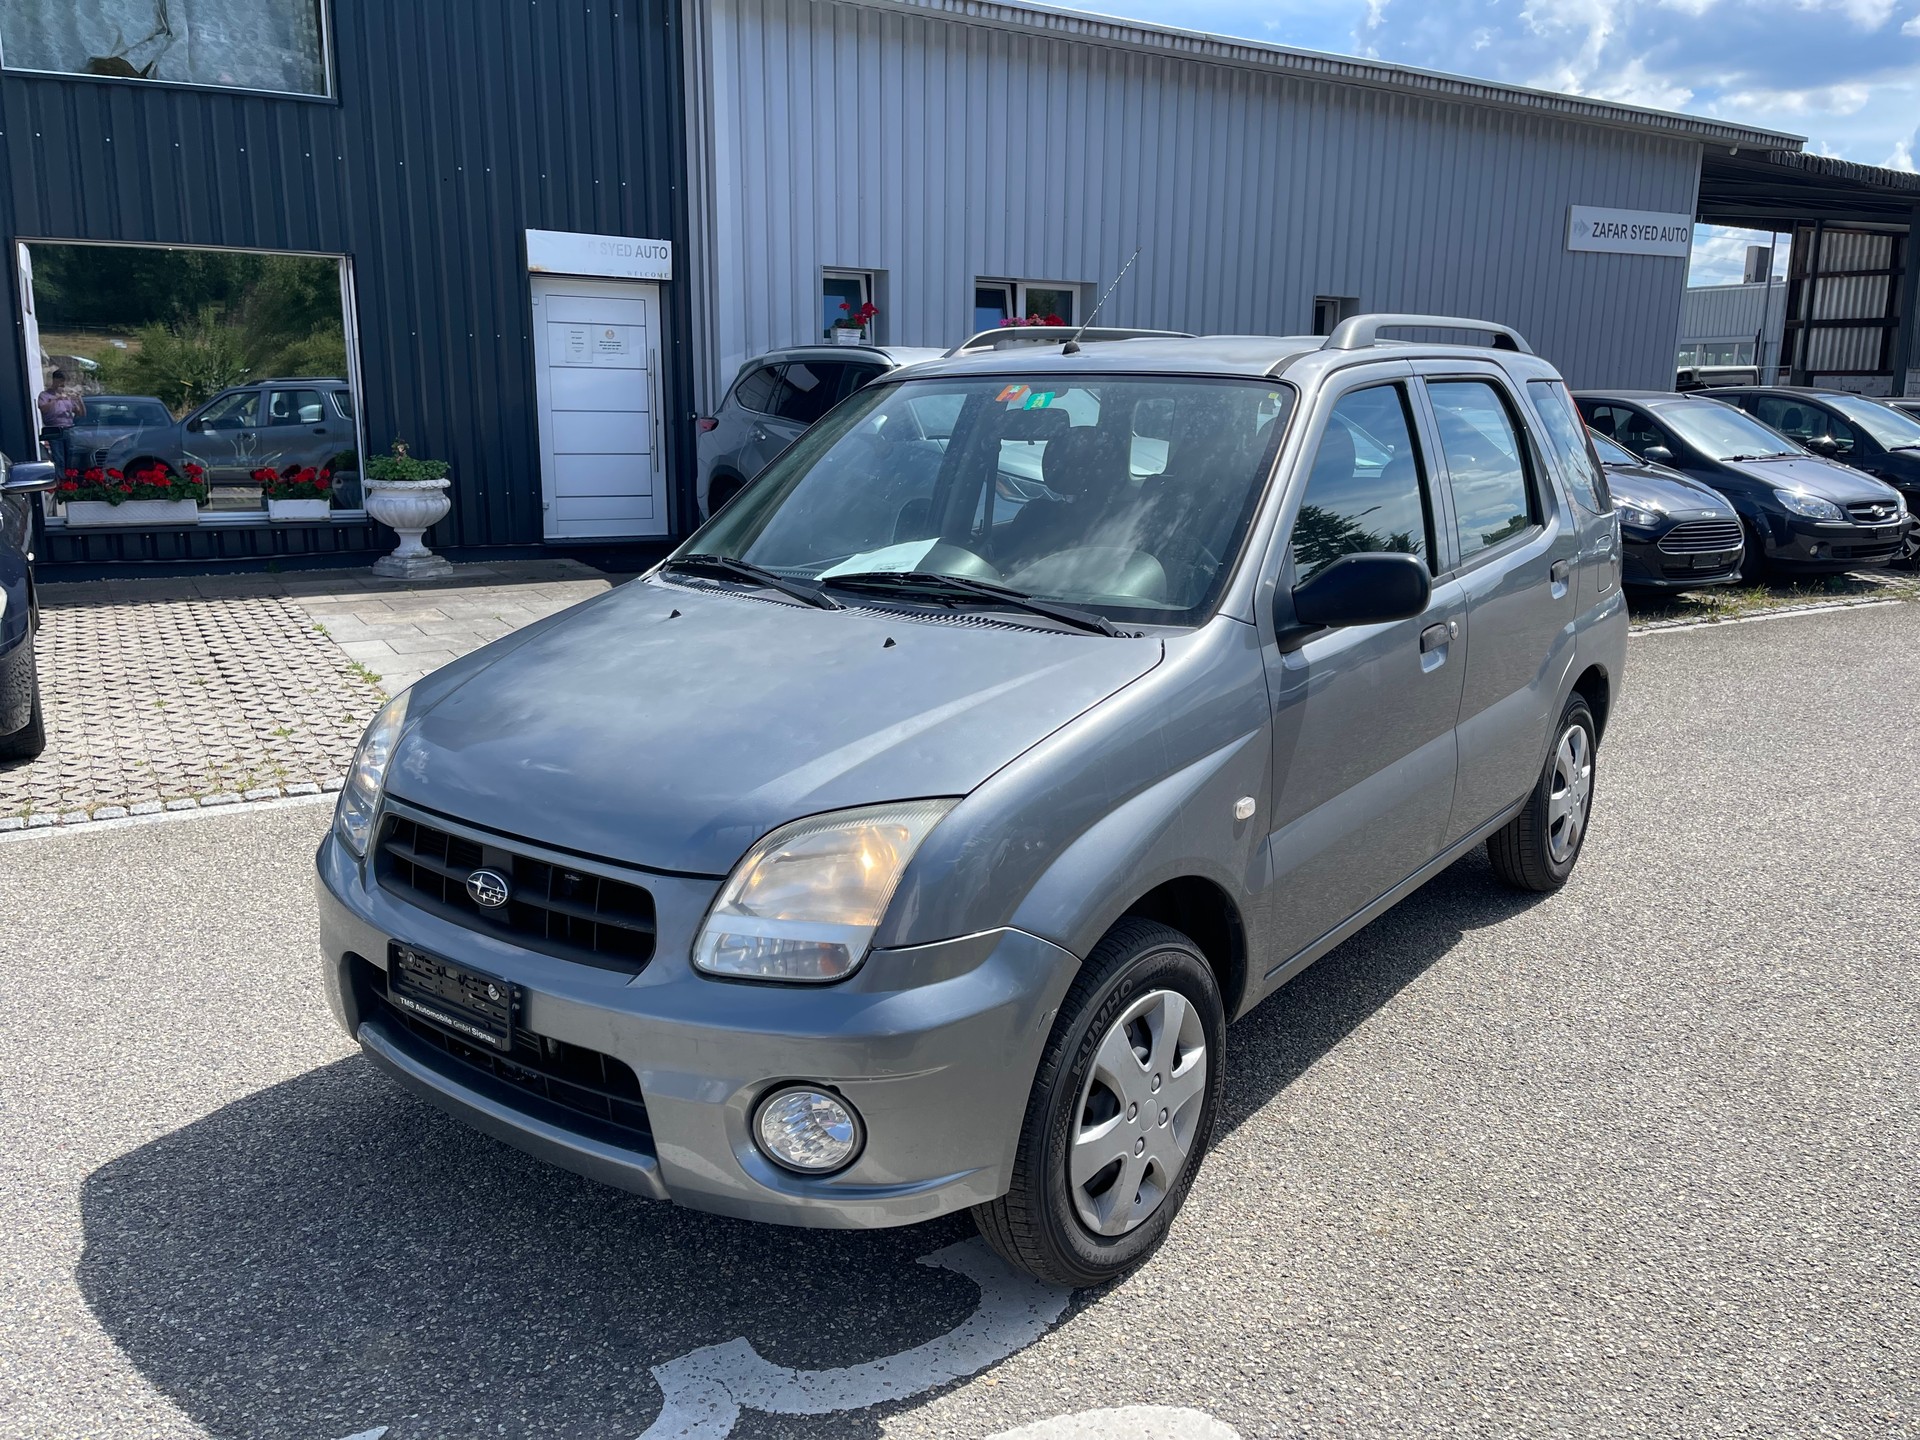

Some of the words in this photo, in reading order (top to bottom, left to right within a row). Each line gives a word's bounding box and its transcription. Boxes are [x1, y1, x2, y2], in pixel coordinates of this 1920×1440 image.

[1592, 221, 1628, 239] ZAFAR
[1630, 224, 1658, 241] SYED
[1659, 226, 1688, 243] AUTO
[600, 242, 632, 257] SYED
[635, 244, 668, 260] AUTO
[626, 270, 670, 279] WELCOME
[400, 996, 415, 1009] TMS
[415, 1003, 453, 1025] Automobile
[453, 1020, 471, 1033] GmbH
[471, 1027, 496, 1044] Signau
[1072, 979, 1133, 1076] KUMHO
